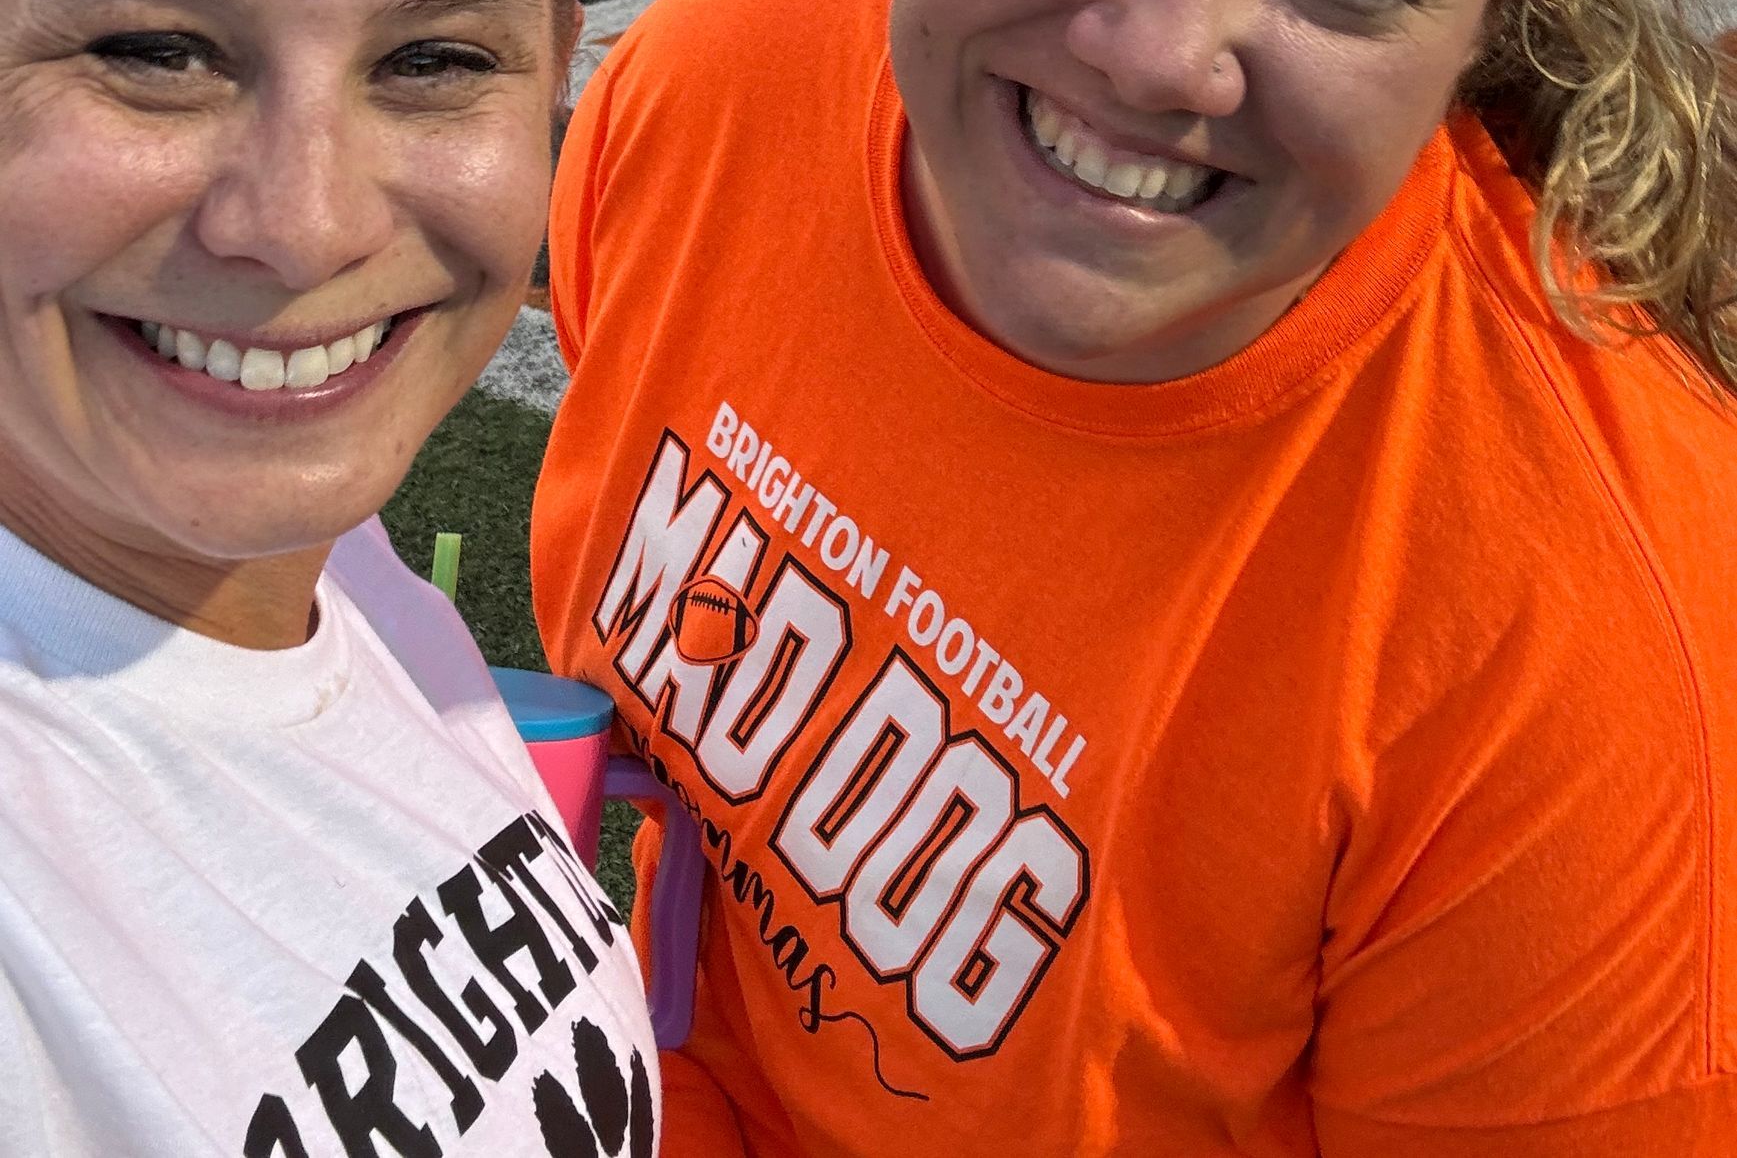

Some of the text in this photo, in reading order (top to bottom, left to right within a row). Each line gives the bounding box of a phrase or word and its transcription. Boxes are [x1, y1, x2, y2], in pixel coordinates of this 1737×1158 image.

[592, 428, 1090, 1062] MAD DOG
[706, 402, 1088, 799] BRIGHTON FOOTBALL
